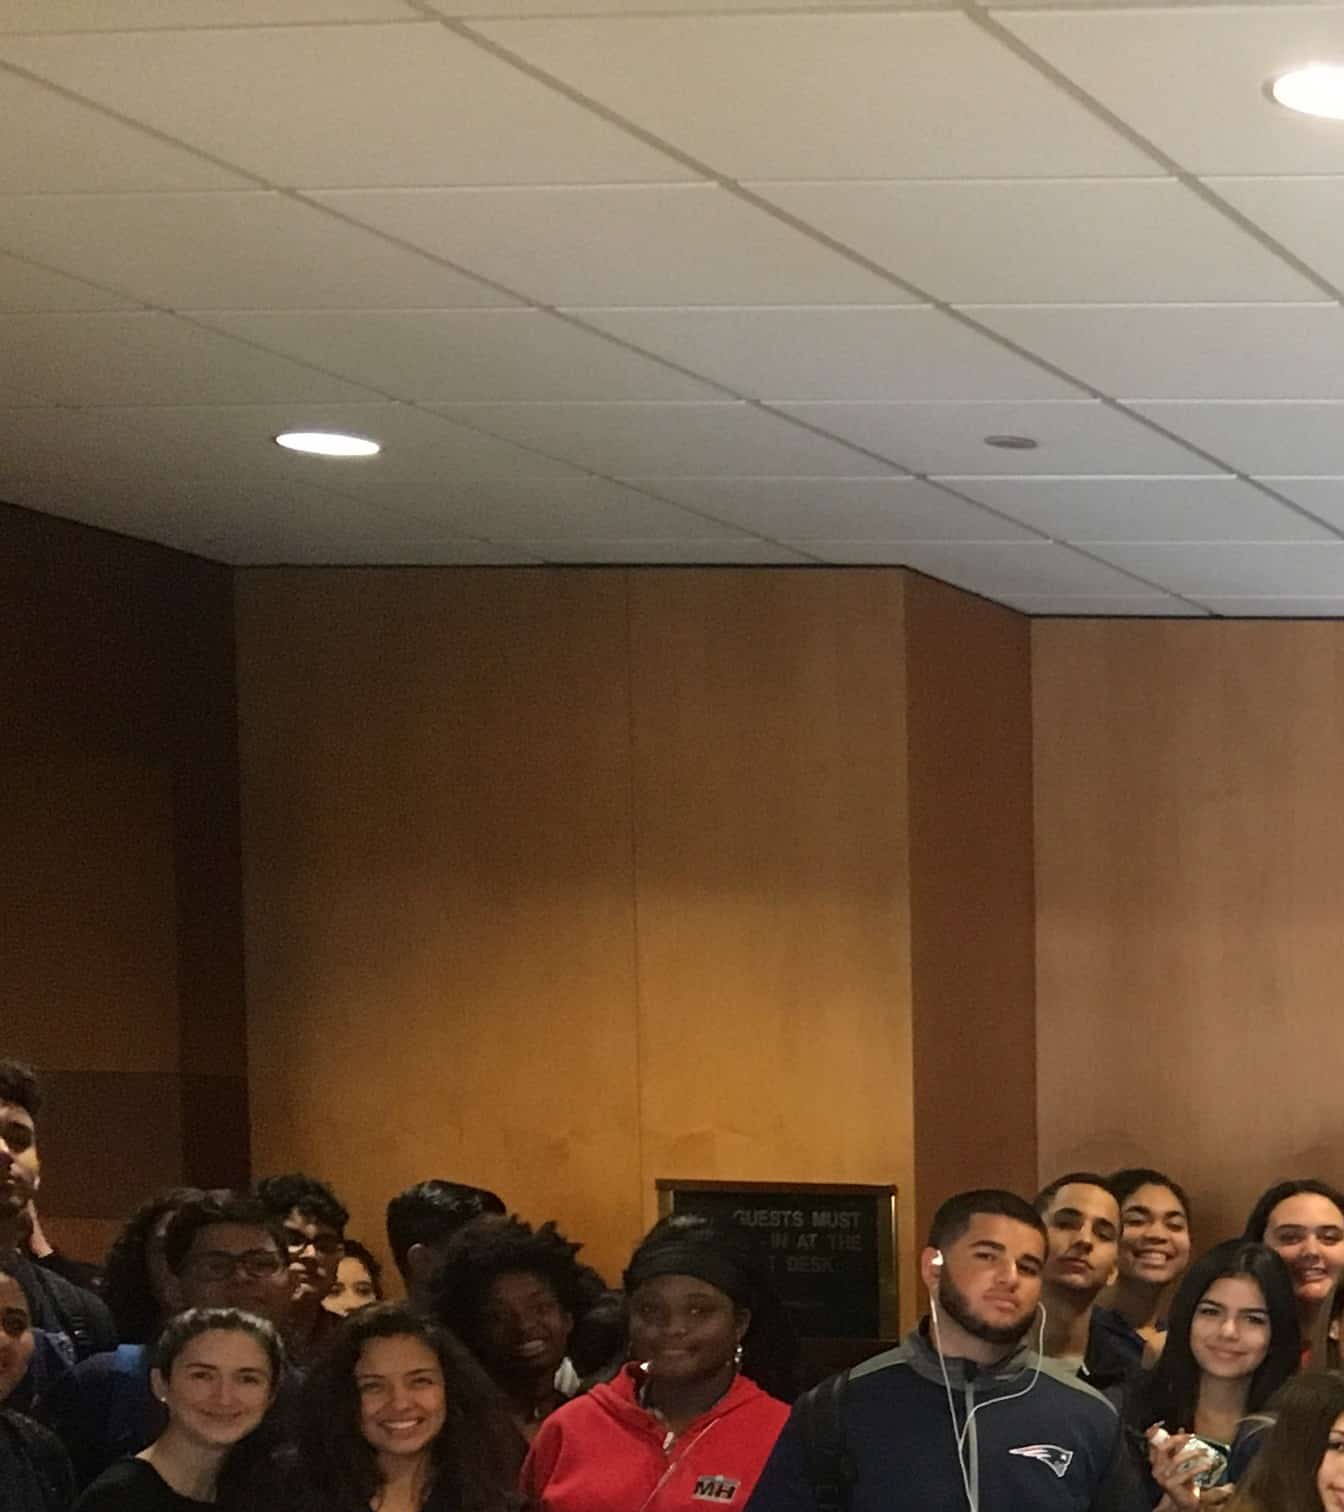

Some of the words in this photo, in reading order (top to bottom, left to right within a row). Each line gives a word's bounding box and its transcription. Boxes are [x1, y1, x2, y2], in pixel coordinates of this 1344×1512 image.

[734, 1209, 804, 1228] GUESTS
[812, 1210, 862, 1228] MUST
[796, 1233, 819, 1249] AT
[696, 1480, 736, 1499] MH
